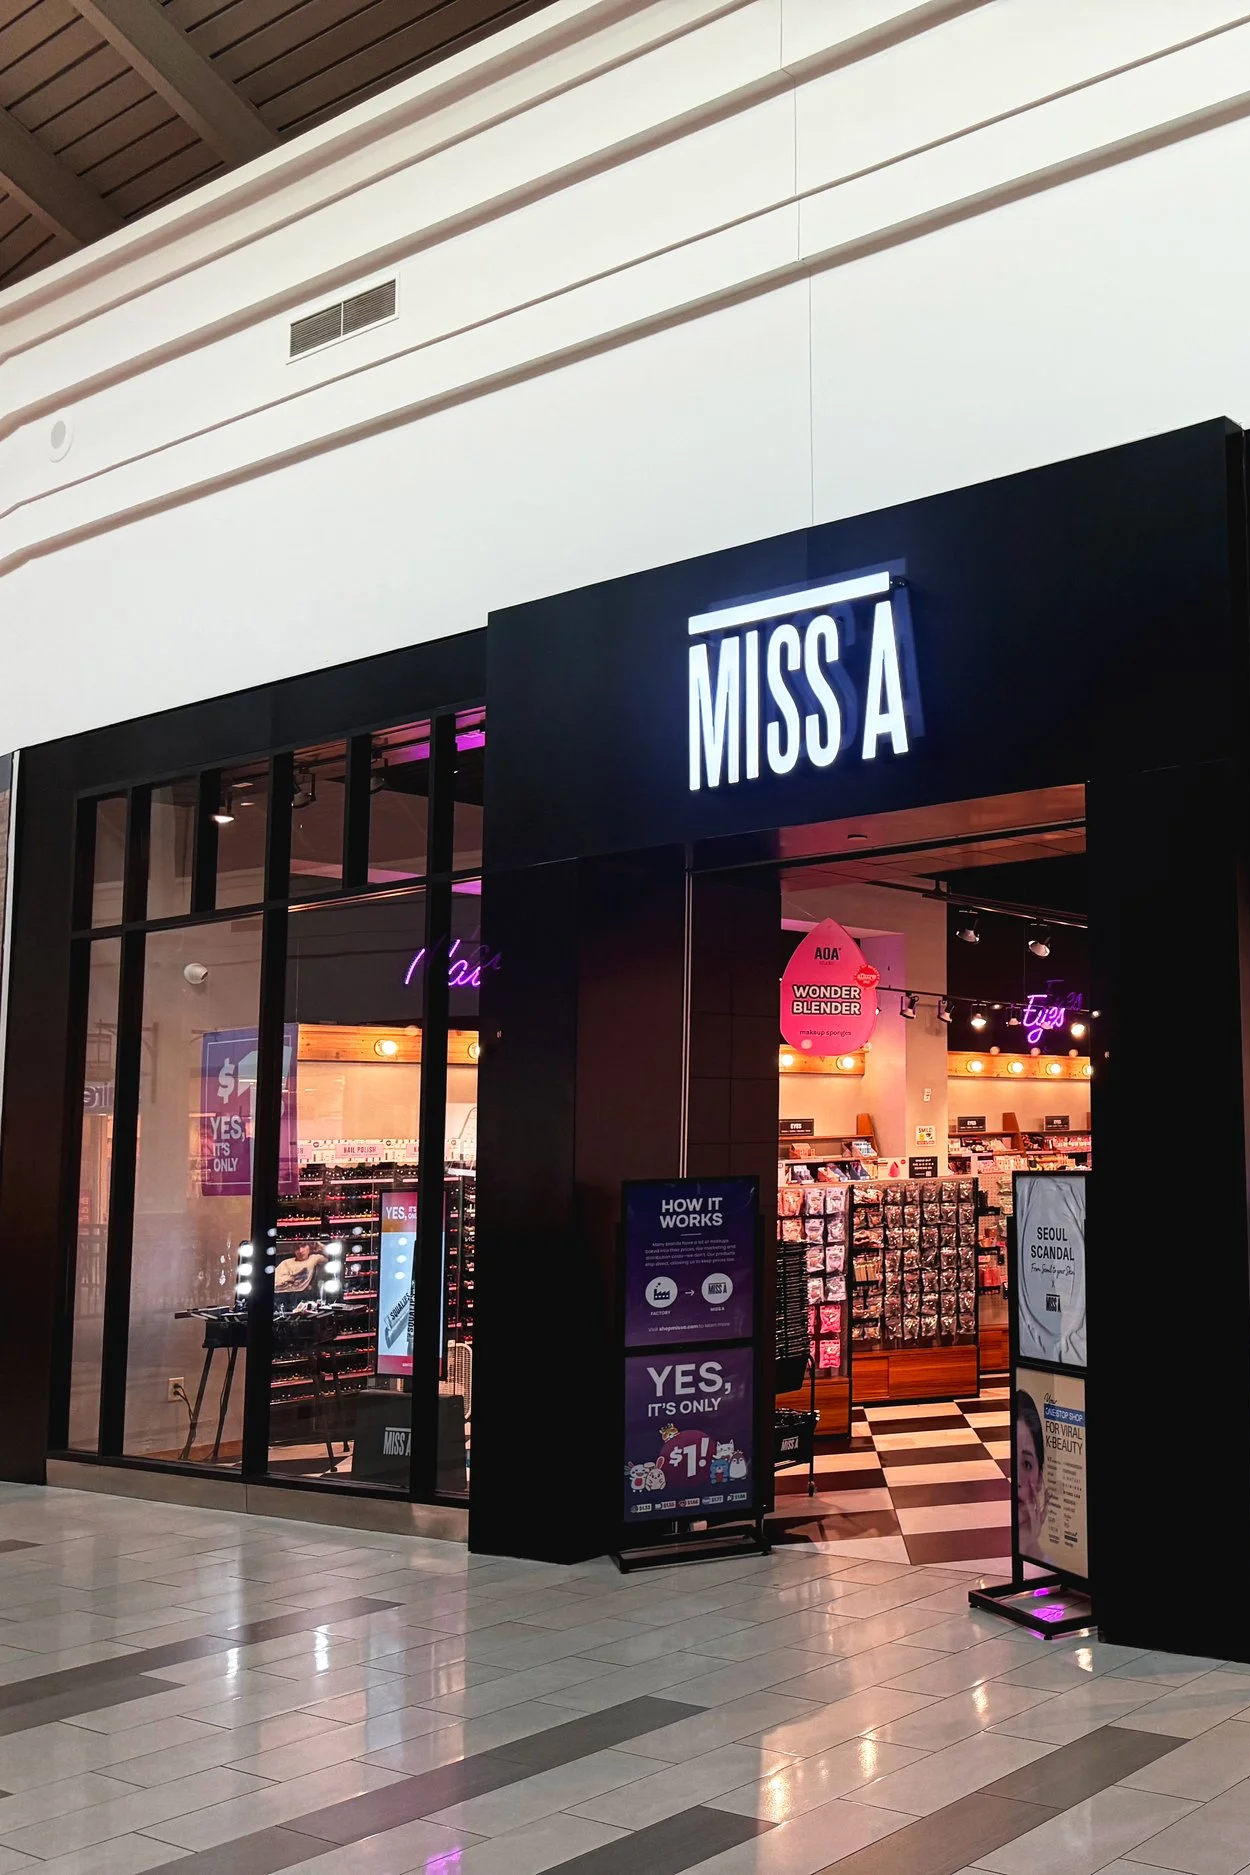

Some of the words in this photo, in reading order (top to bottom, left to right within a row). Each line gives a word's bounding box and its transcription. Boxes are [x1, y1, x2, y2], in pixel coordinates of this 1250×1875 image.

[688, 614, 842, 792] MISS
[862, 600, 909, 760] A
[815, 947, 839, 960] AOA
[792, 984, 861, 999] WONDER
[792, 1000, 861, 1015] BLENDER
[1023, 995, 1065, 1043] Eyes
[211, 1116, 245, 1142] YES,
[214, 1142, 230, 1157] IT'S
[214, 1158, 238, 1173] ONLY
[662, 1198, 703, 1212] HOW
[708, 1197, 722, 1210] IT
[386, 1207, 408, 1220] YES,
[660, 1213, 722, 1228] WORKS
[1037, 1227, 1068, 1241] SEOUL
[1031, 1245, 1074, 1261] SCANDAL
[708, 1282, 722, 1294] MISS
[723, 1282, 727, 1294] A
[647, 1361, 731, 1397] YES,
[648, 1402, 676, 1417] IT'S
[680, 1398, 721, 1414] ONLY
[1069, 1412, 1082, 1421] SHOP
[1046, 1421, 1059, 1434] FOR
[1061, 1424, 1082, 1440] VIRAL
[383, 1431, 405, 1456] MISS
[1046, 1435, 1082, 1455] K-BEAUTY
[669, 1437, 709, 1477] $1!
